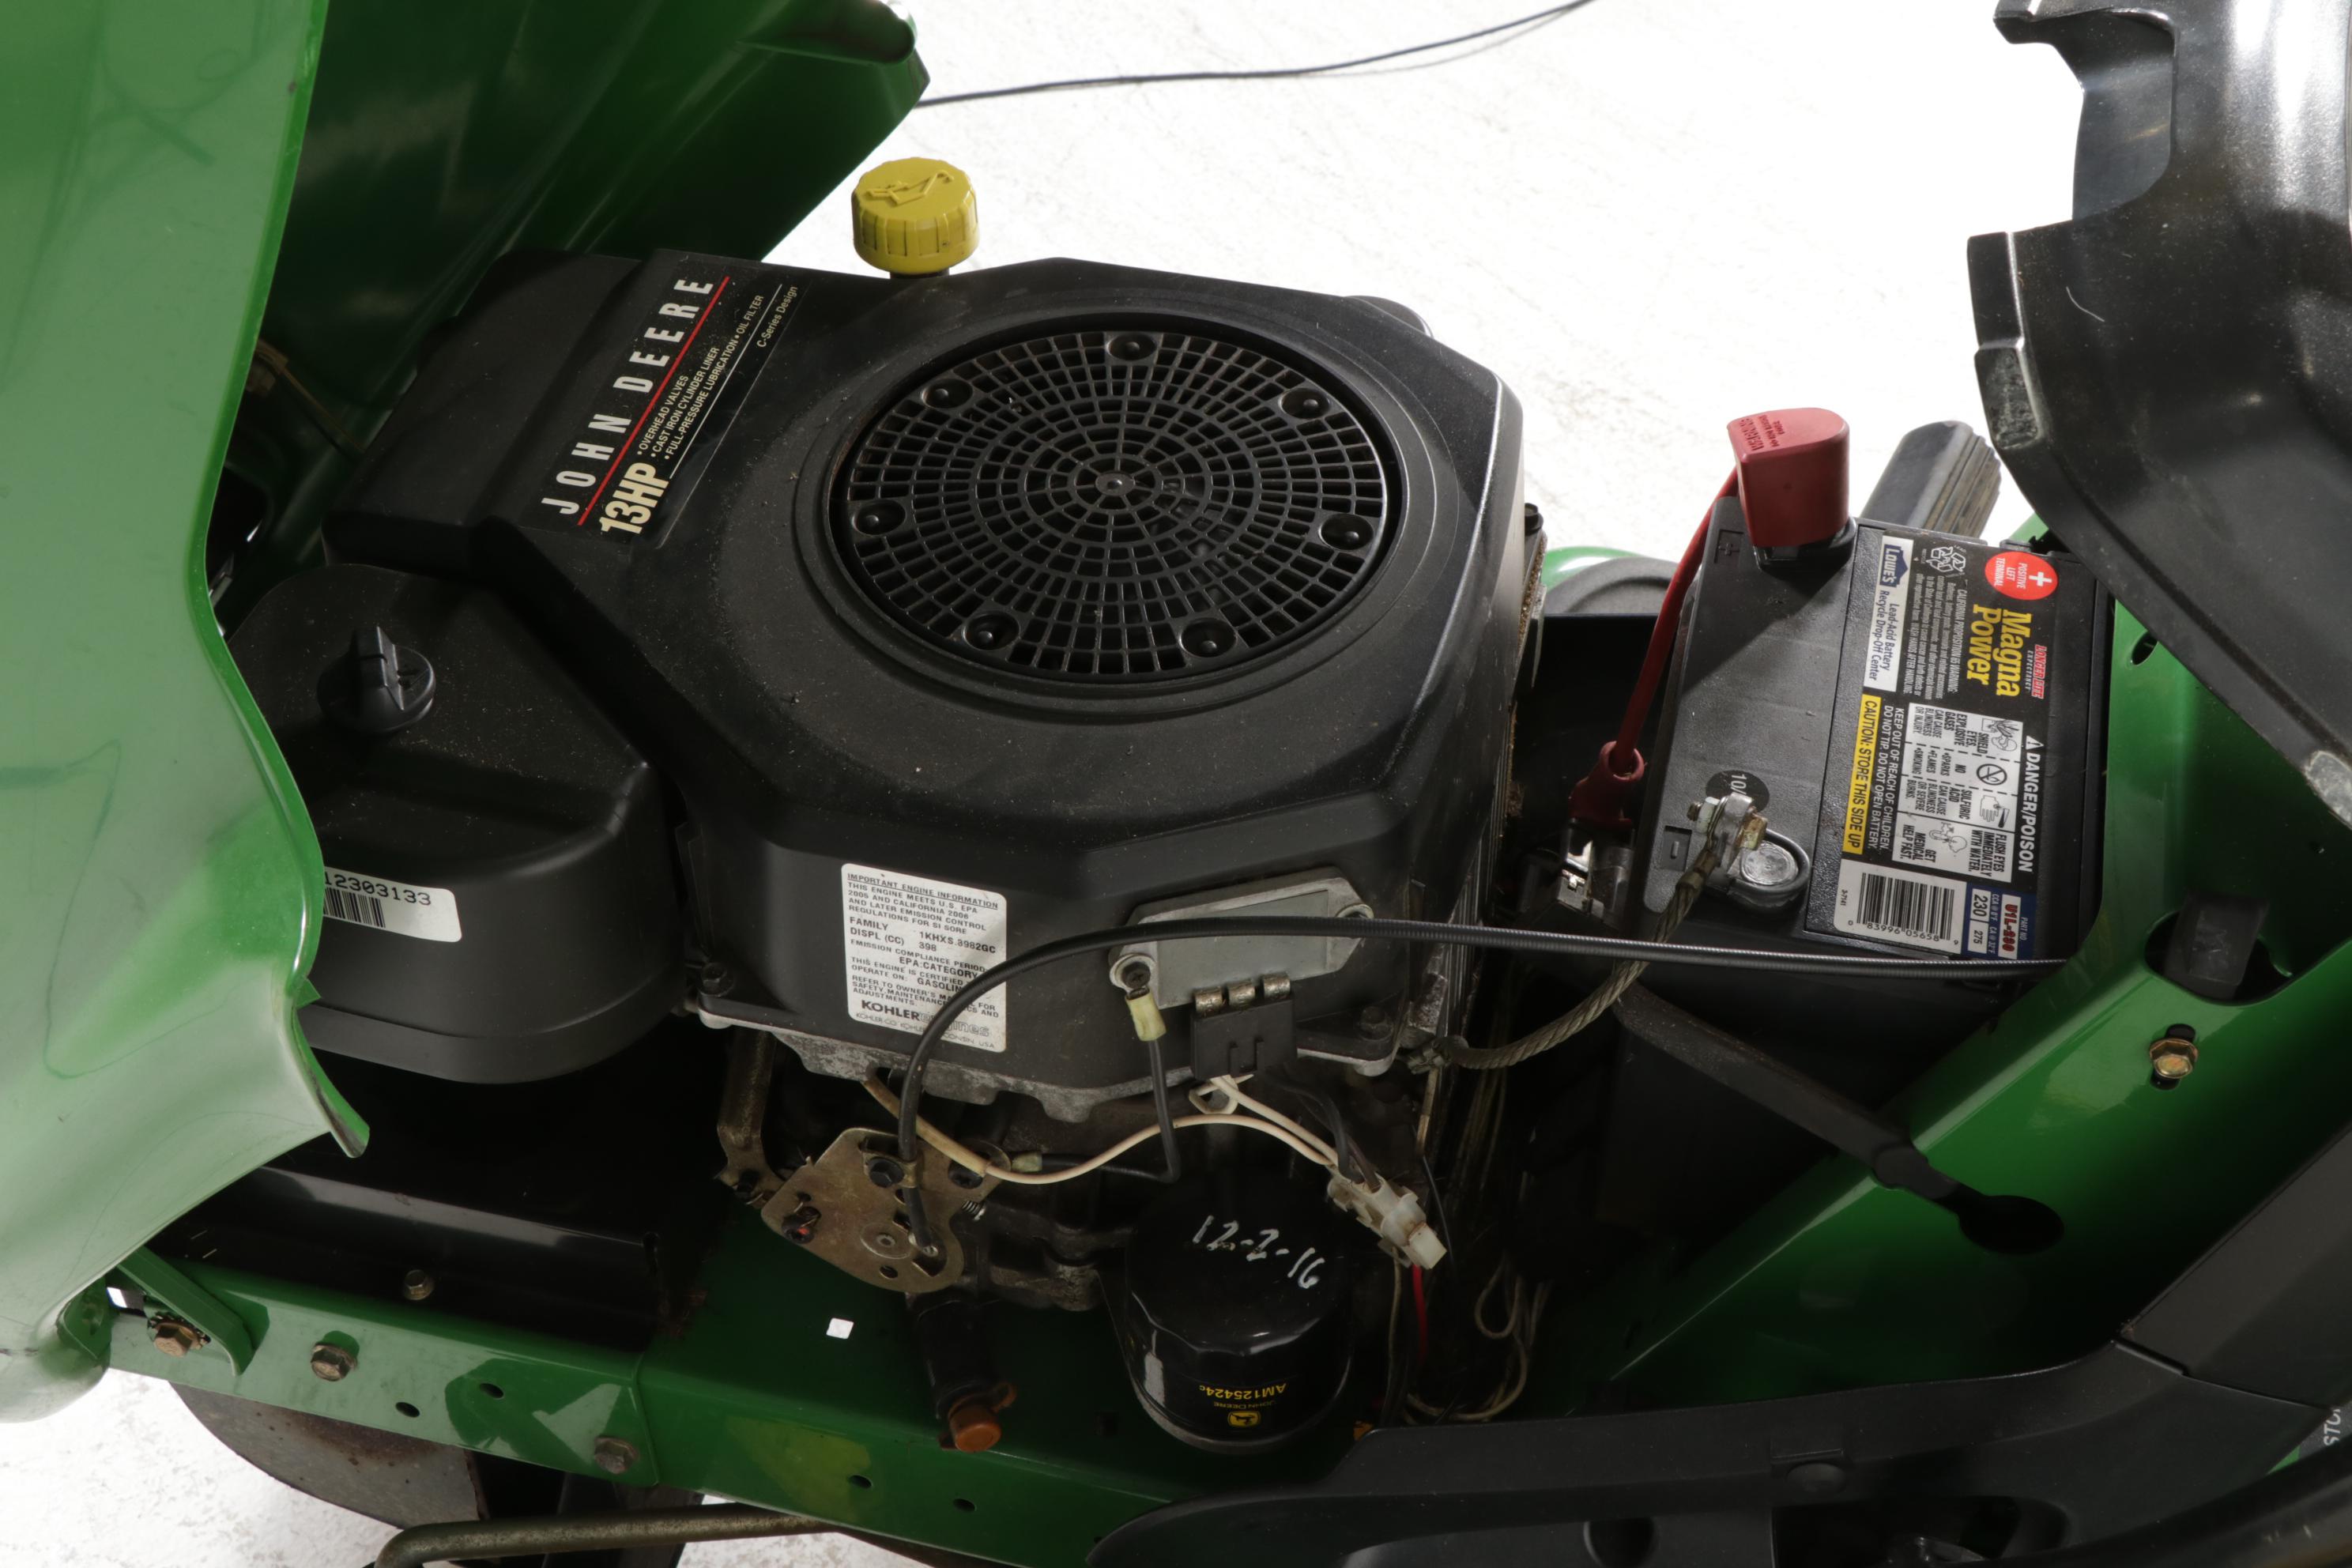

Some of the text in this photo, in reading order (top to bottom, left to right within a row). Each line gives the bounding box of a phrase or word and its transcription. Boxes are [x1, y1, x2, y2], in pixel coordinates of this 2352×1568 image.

[756, 286, 797, 348] C-Series Design
[667, 295, 763, 460] FULL-PRESSURE LUBRICATION OIL FILTER
[541, 279, 714, 514] JOHN DEERE
[654, 347, 720, 454] CAST IRON CYLINDER LINER
[640, 375, 689, 450] OVERHEAD VALVES
[598, 462, 670, 534] 13HP
[1883, 548, 1899, 583] LOWE'S
[1994, 557, 2005, 587] TERMINAL
[2007, 567, 2015, 581] LEFT
[2017, 563, 2027, 589] POSITIVE
[1955, 589, 1966, 620] CALIFORNIA
[1870, 590, 1889, 680] Recycle Drop-Off Center
[1880, 604, 1899, 671] Lead-Acid Battery
[1952, 621, 1964, 657] PROPOSITION
[1966, 604, 2001, 686] Power
[1990, 608, 2032, 699] Magna
[2032, 644, 2047, 699] LONGER LIFE
[1924, 708, 1934, 737] BLINDNESS
[1933, 722, 1943, 738] CAUSE
[1944, 711, 1955, 731] GASES
[1954, 714, 1967, 746] EXPLOSIVE
[1977, 733, 1988, 754] SHIELD
[1848, 700, 1877, 848] CAUTION: STORE THIS SIDE UP
[1868, 705, 1894, 850] DO NOT TIP. DO NOT OPEN BATTERY.
[1880, 707, 1904, 851] KEEP OUT OF REACH OF CHILDREN.
[1955, 764, 1966, 774] NO
[1916, 790, 1925, 811] SEVERE
[1927, 783, 1937, 813] BLINDNESS
[1937, 786, 1947, 816] CAN CAUSE
[1950, 787, 1960, 802] ACID
[1959, 789, 1972, 820] SULFURIC
[2018, 752, 2040, 872] DANGER/POISON
[1901, 824, 1914, 860] HELP FAST.
[1913, 832, 1925, 861] MEDICAL
[1925, 850, 1936, 862] GET
[1969, 830, 1982, 873] WITH WATER.
[1981, 831, 1994, 876] IMMEDIATELY
[1994, 834, 2007, 872] FLUSH EYES
[847, 873, 997, 908] IMPORTANT ENGINE INFORMATION
[847, 881, 867, 891] THIS
[871, 887, 903, 898] ENGINE
[906, 894, 935, 905] MEETS
[848, 889, 968, 919] 2005 AND CALIFORNIA 2006
[1973, 895, 1988, 917] 230
[848, 904, 908, 922] REGULATIONS
[912, 918, 929, 926] FOR
[944, 925, 966, 934] SORE
[849, 897, 986, 930] AND LATER EMISSION CONTROL
[849, 916, 888, 931] FAMILY
[850, 926, 936, 952] DISPL (CC) 398
[1868, 923, 1900, 934] 83996
[1906, 930, 1939, 941] 05658
[1973, 930, 1983, 944] 275
[850, 939, 891, 952] EMISSION
[895, 948, 950, 965] COMPLIANCE
[851, 956, 870, 965] THIS
[874, 961, 904, 973] ENGINE
[919, 971, 963, 986] CERTIFIED
[851, 963, 888, 977] OPERATE
[917, 977, 961, 993] GASOLIN
[852, 974, 878, 985] REFER
[896, 984, 936, 998] OWNER'S
[978, 1002, 995, 1011] FOR
[853, 986, 917, 1006] ADJUSTMENTS.
[861, 1000, 919, 1021] KOHLER
[981, 1009, 998, 1018] AND
[1192, 1215, 1325, 1289] 12-2-16
[2324, 1408, 2341, 1446] STO
